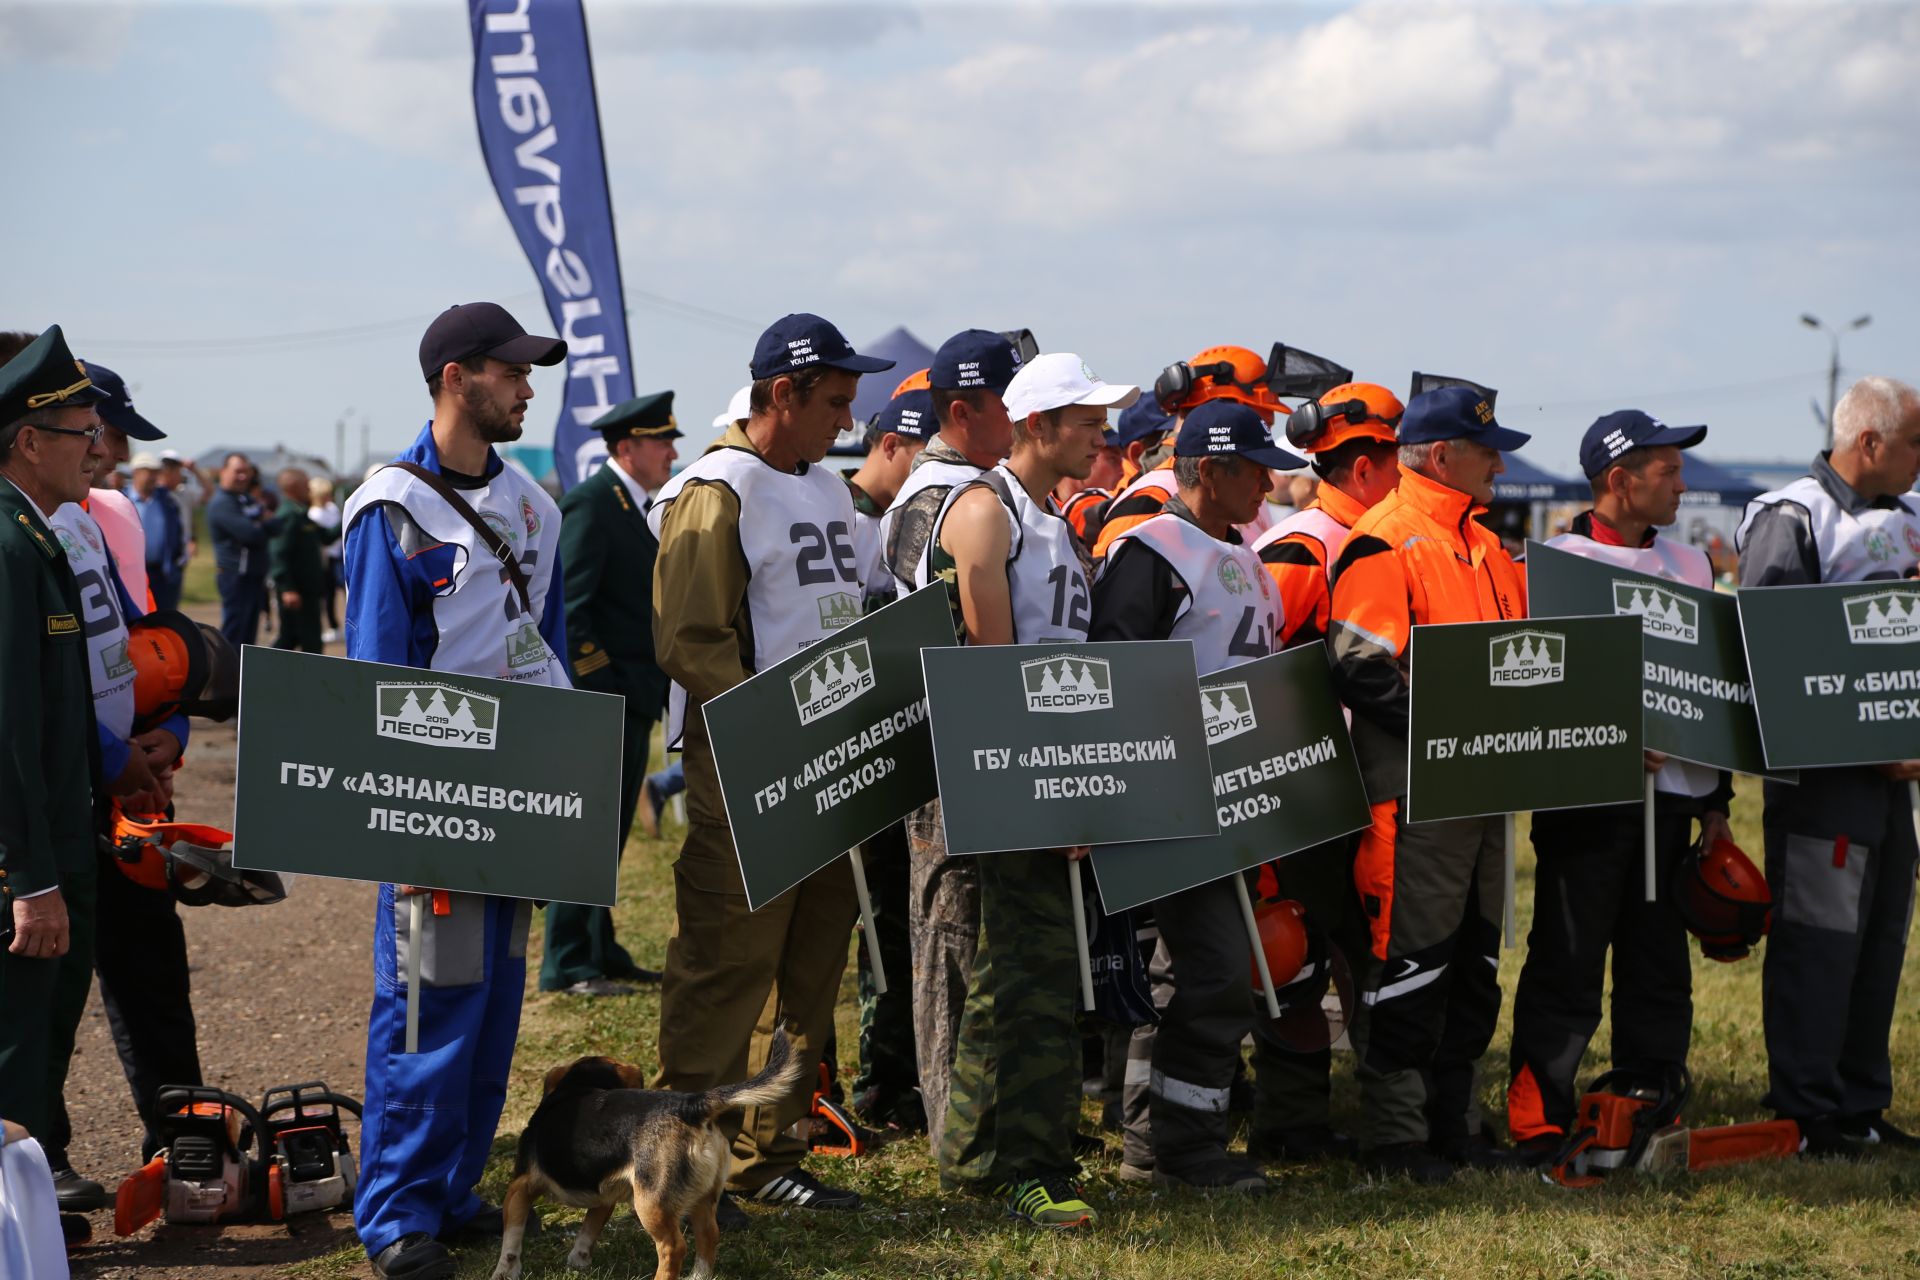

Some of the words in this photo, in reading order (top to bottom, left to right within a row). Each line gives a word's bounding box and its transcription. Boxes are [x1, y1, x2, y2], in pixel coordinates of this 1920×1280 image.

[788, 338, 811, 349] READY
[792, 347, 812, 356] WHEN
[790, 356, 804, 366] YOU
[805, 354, 820, 363] ARE
[958, 362, 980, 370] READY
[958, 379, 971, 387] YOU
[902, 410, 922, 419] READY
[902, 417, 919, 426] WHEN
[897, 425, 909, 433] YOU
[909, 426, 922, 435] ARE
[1602, 428, 1622, 445] READY
[1608, 435, 1626, 450] WHEN
[1609, 446, 1622, 459] YOU
[1621, 439, 1635, 451] ARE
[790, 521, 859, 586] 26
[1048, 564, 1091, 634] 12
[1228, 606, 1274, 658] 41
[1854, 625, 1920, 640] ЛЕСОР
[1493, 667, 1561, 681] ЛЕСОРУБ
[1643, 661, 1755, 705] ВЛИНСКИЙ
[827, 679, 842, 691] 2019
[1804, 674, 1846, 696] ГБУ
[802, 673, 872, 720] ЛЕСОРУБ
[1030, 693, 1110, 708] ЛЕСОРУБ
[426, 715, 449, 724] 2019
[1206, 715, 1252, 738] ОРУБ
[381, 720, 492, 745] ЛЕСОРУБ
[1427, 737, 1458, 760] ГБУ
[1462, 726, 1542, 756] «АРСКИЙ
[1547, 724, 1628, 749] ЛЕСХОЗ»
[973, 748, 1011, 770] ГБУ
[1018, 735, 1177, 767] «АЛЬКЕЕВСКИЙ
[280, 762, 334, 789] ГБУ
[342, 772, 583, 819] «АЗНАКАЕВСКИЙ
[755, 776, 787, 814] ГБУ
[815, 757, 896, 815] ЛЕСХОЗ»
[1034, 775, 1127, 799] ЛЕСХОЗ»
[367, 808, 496, 842] ЛЕСХОЗ»
